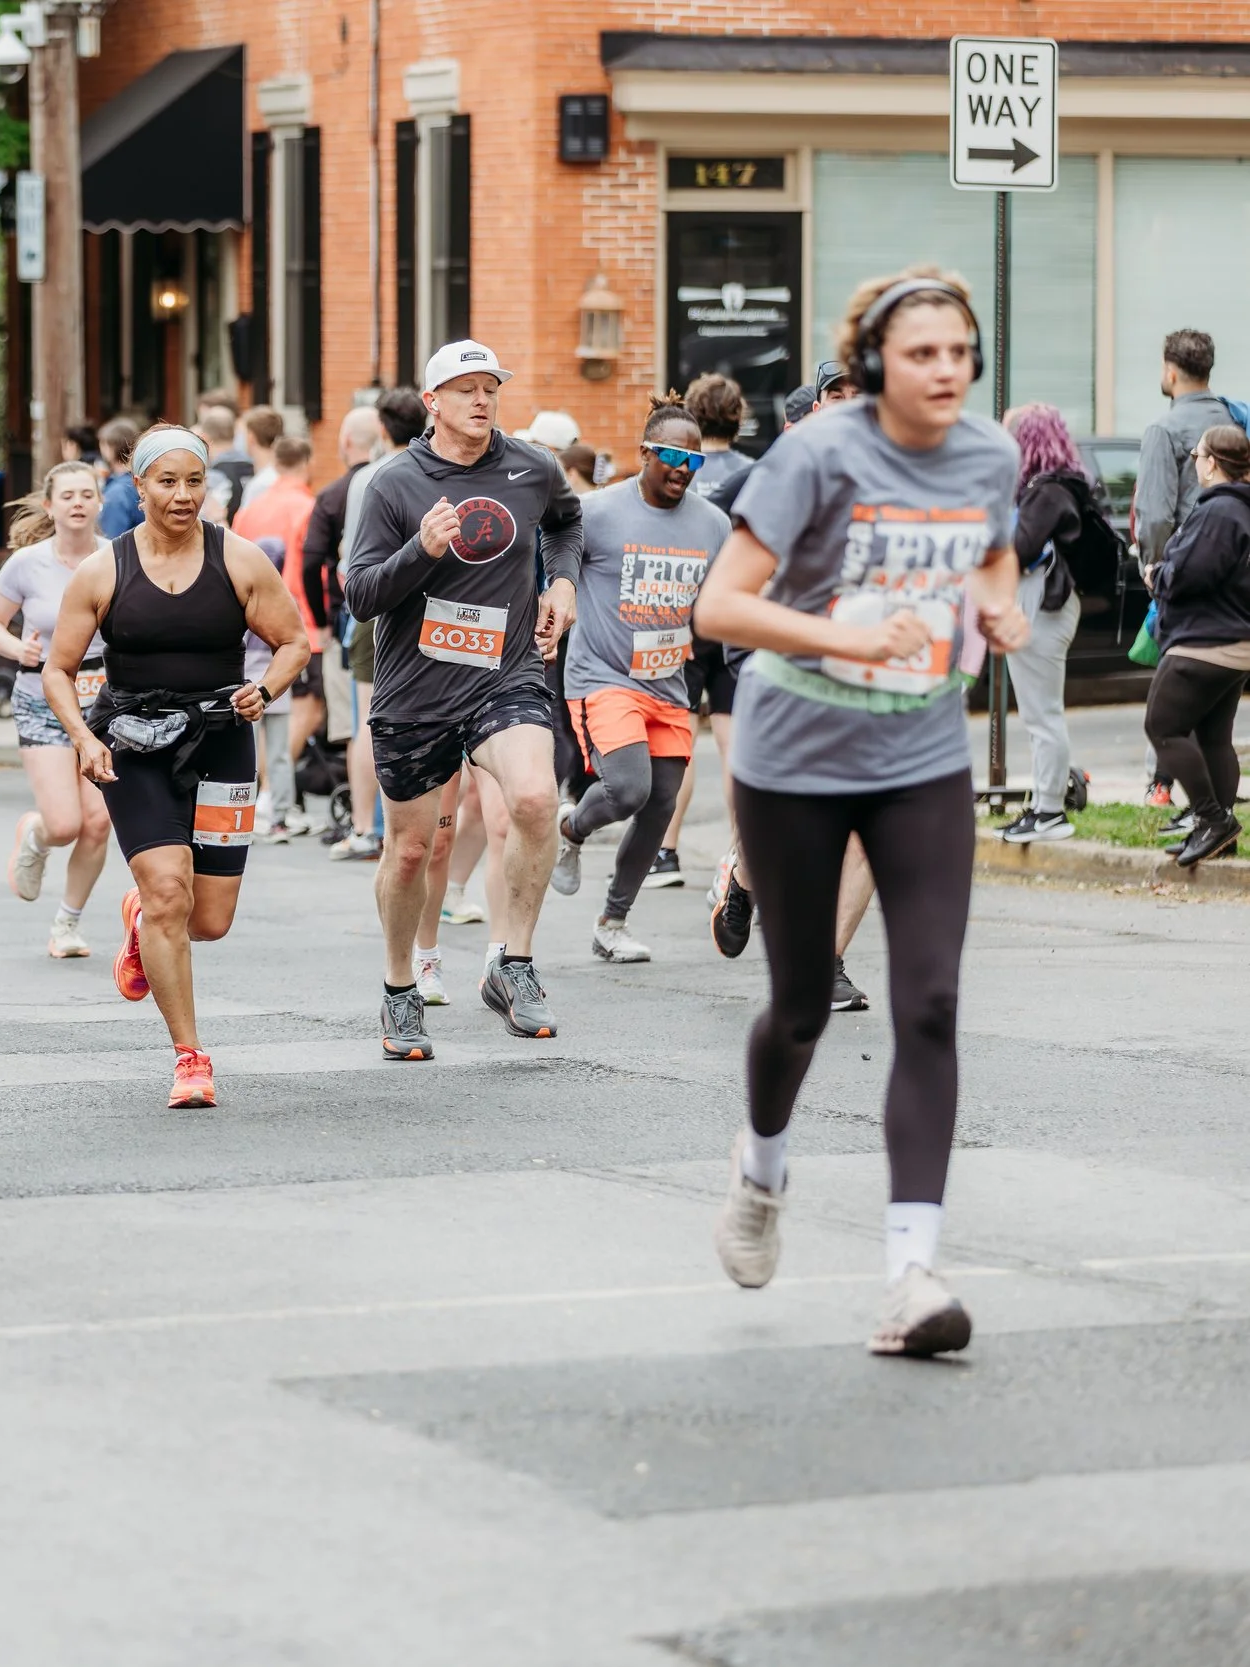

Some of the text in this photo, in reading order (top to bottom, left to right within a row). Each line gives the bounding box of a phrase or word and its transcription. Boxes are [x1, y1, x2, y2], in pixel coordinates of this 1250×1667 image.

[967, 52, 1039, 85] ONE
[968, 94, 1042, 127] WAY
[695, 162, 757, 187] 147
[619, 602, 654, 615] APRIL
[430, 626, 496, 652] 6033
[641, 648, 683, 668] 1062
[234, 810, 243, 830] 1
